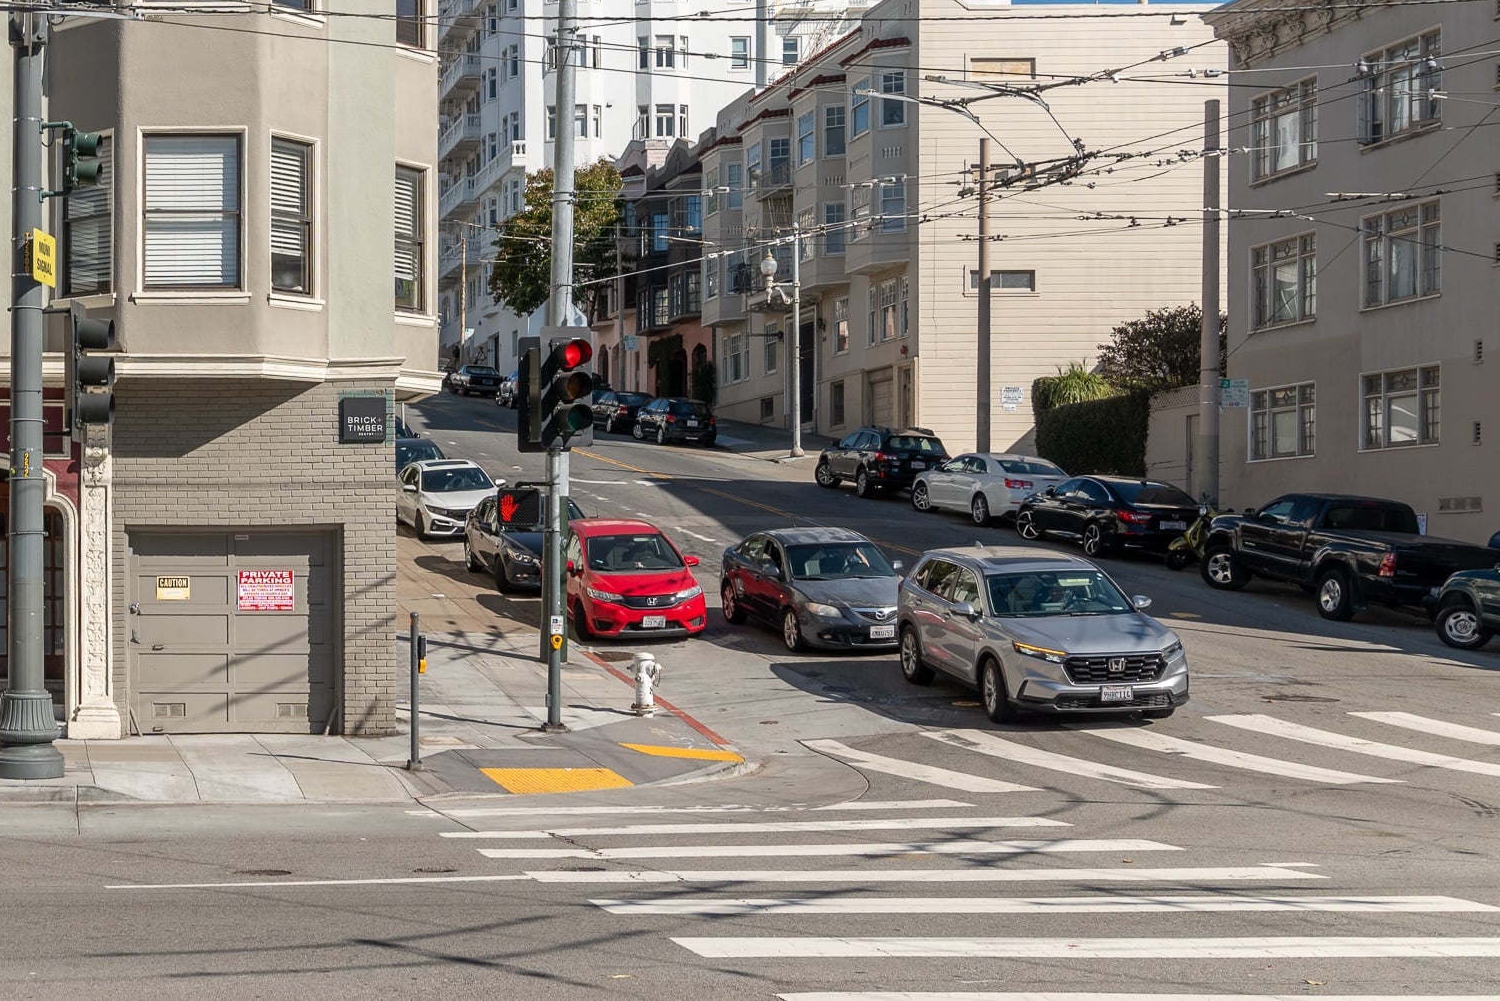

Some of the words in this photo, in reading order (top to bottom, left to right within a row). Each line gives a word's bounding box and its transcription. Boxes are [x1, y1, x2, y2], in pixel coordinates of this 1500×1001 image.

[39, 241, 51, 257] MUNI
[37, 258, 52, 276] SIGNAL
[160, 579, 187, 587] CAUTION
